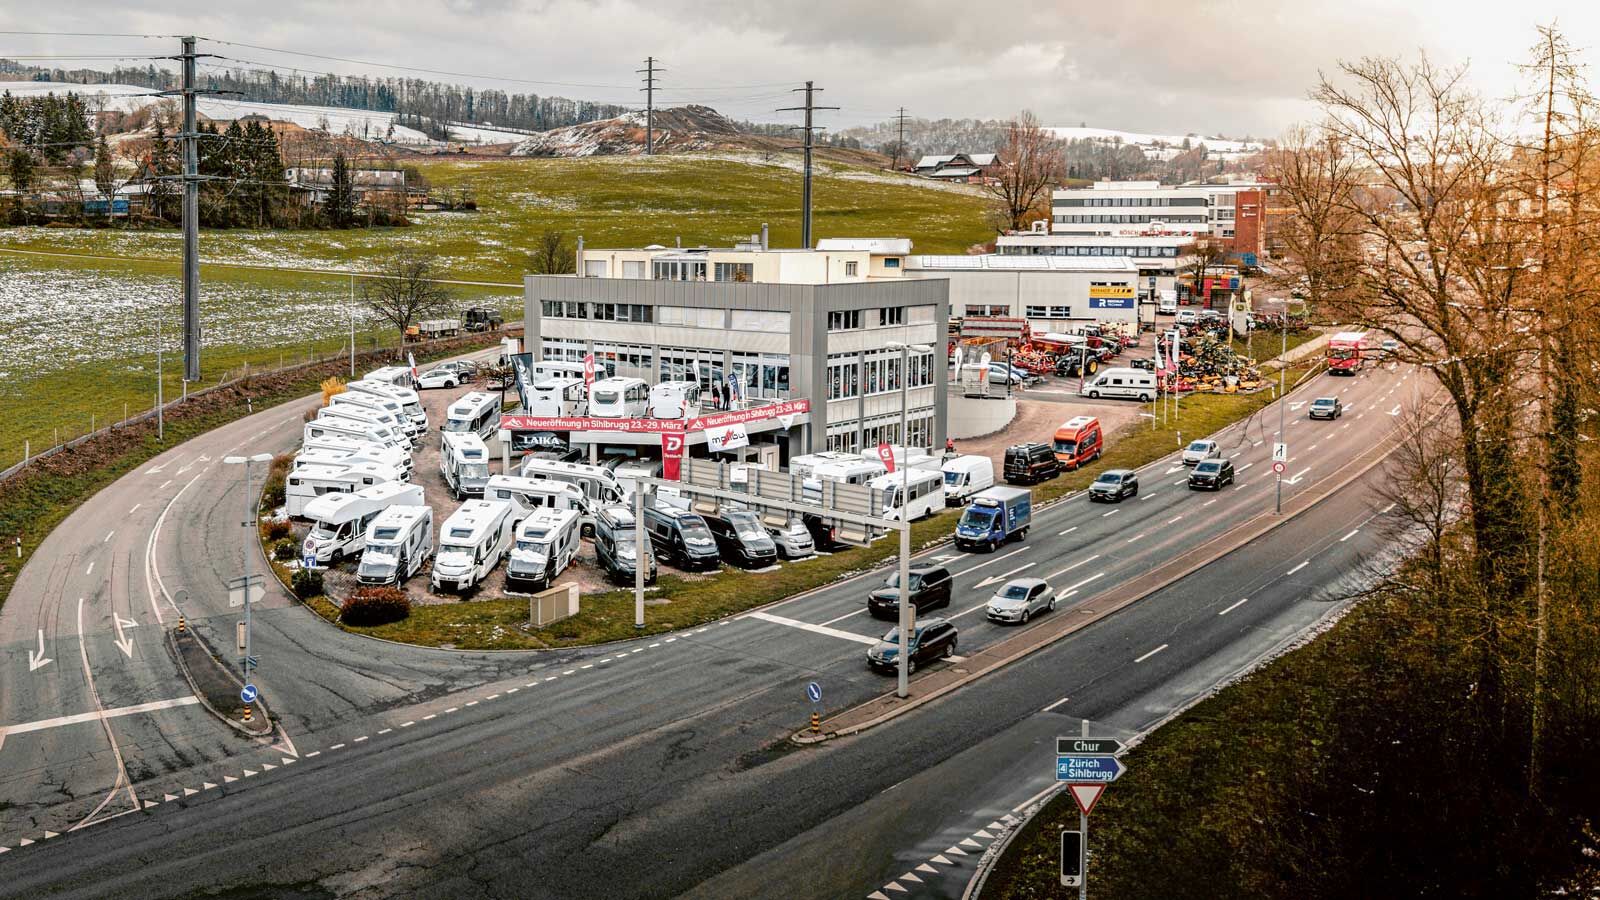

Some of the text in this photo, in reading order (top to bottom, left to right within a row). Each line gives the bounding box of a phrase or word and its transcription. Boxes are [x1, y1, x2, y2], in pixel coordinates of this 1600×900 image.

[526, 418, 582, 428] Neueröffnung
[591, 420, 629, 429] Sihlbrugg
[631, 420, 659, 429] 23.-29.
[661, 421, 682, 430] März
[524, 436, 560, 445] LAIKA
[667, 437, 681, 451] D
[1073, 741, 1100, 752] Chur
[1069, 758, 1100, 768] Zürich
[1069, 768, 1113, 780] Sihlbrugg
